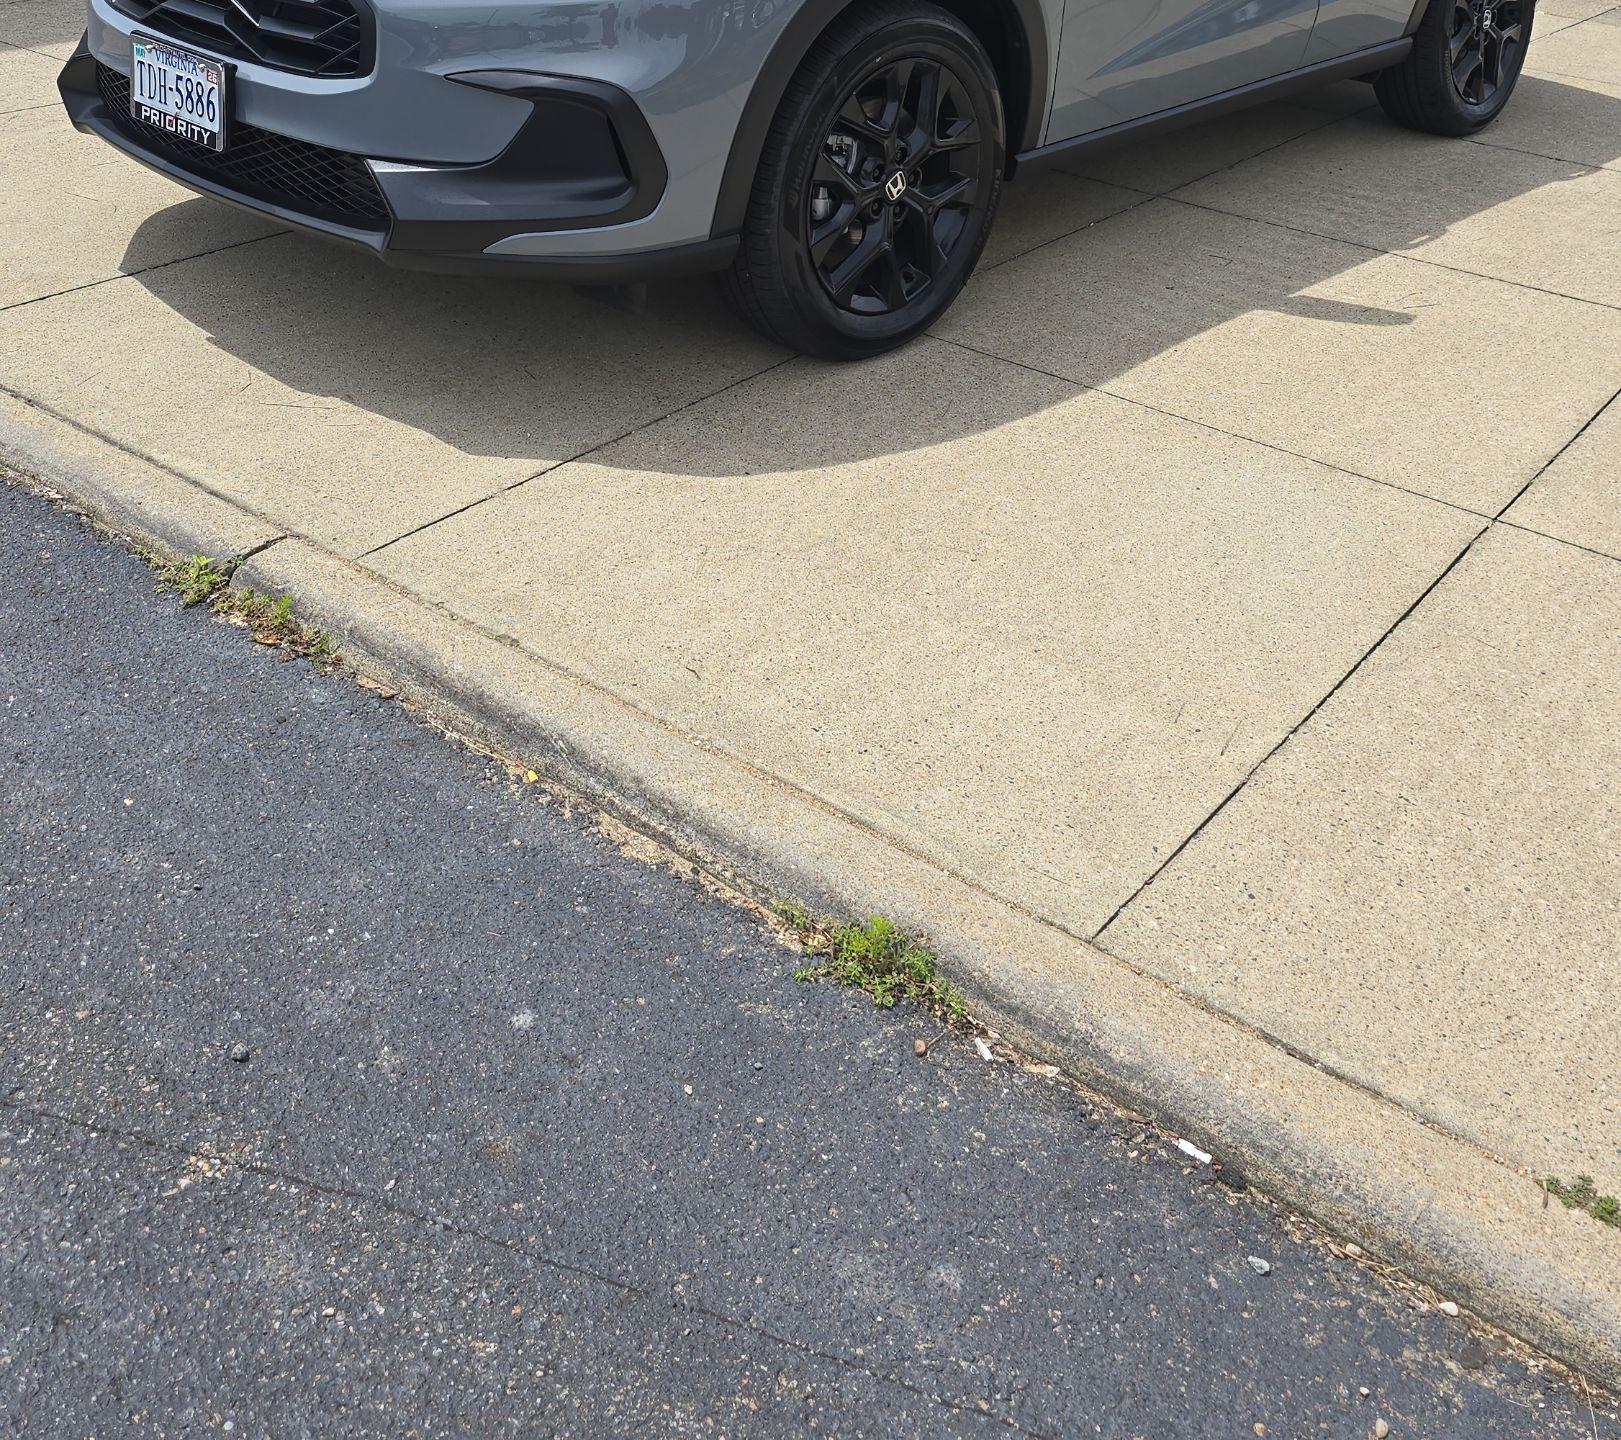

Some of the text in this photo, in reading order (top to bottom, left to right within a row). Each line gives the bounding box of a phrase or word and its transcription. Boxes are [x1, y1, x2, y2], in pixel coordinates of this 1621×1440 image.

[155, 49, 199, 76] VIRGINIA
[136, 60, 216, 123] TDH-5886
[141, 105, 211, 145] PRIORITY
